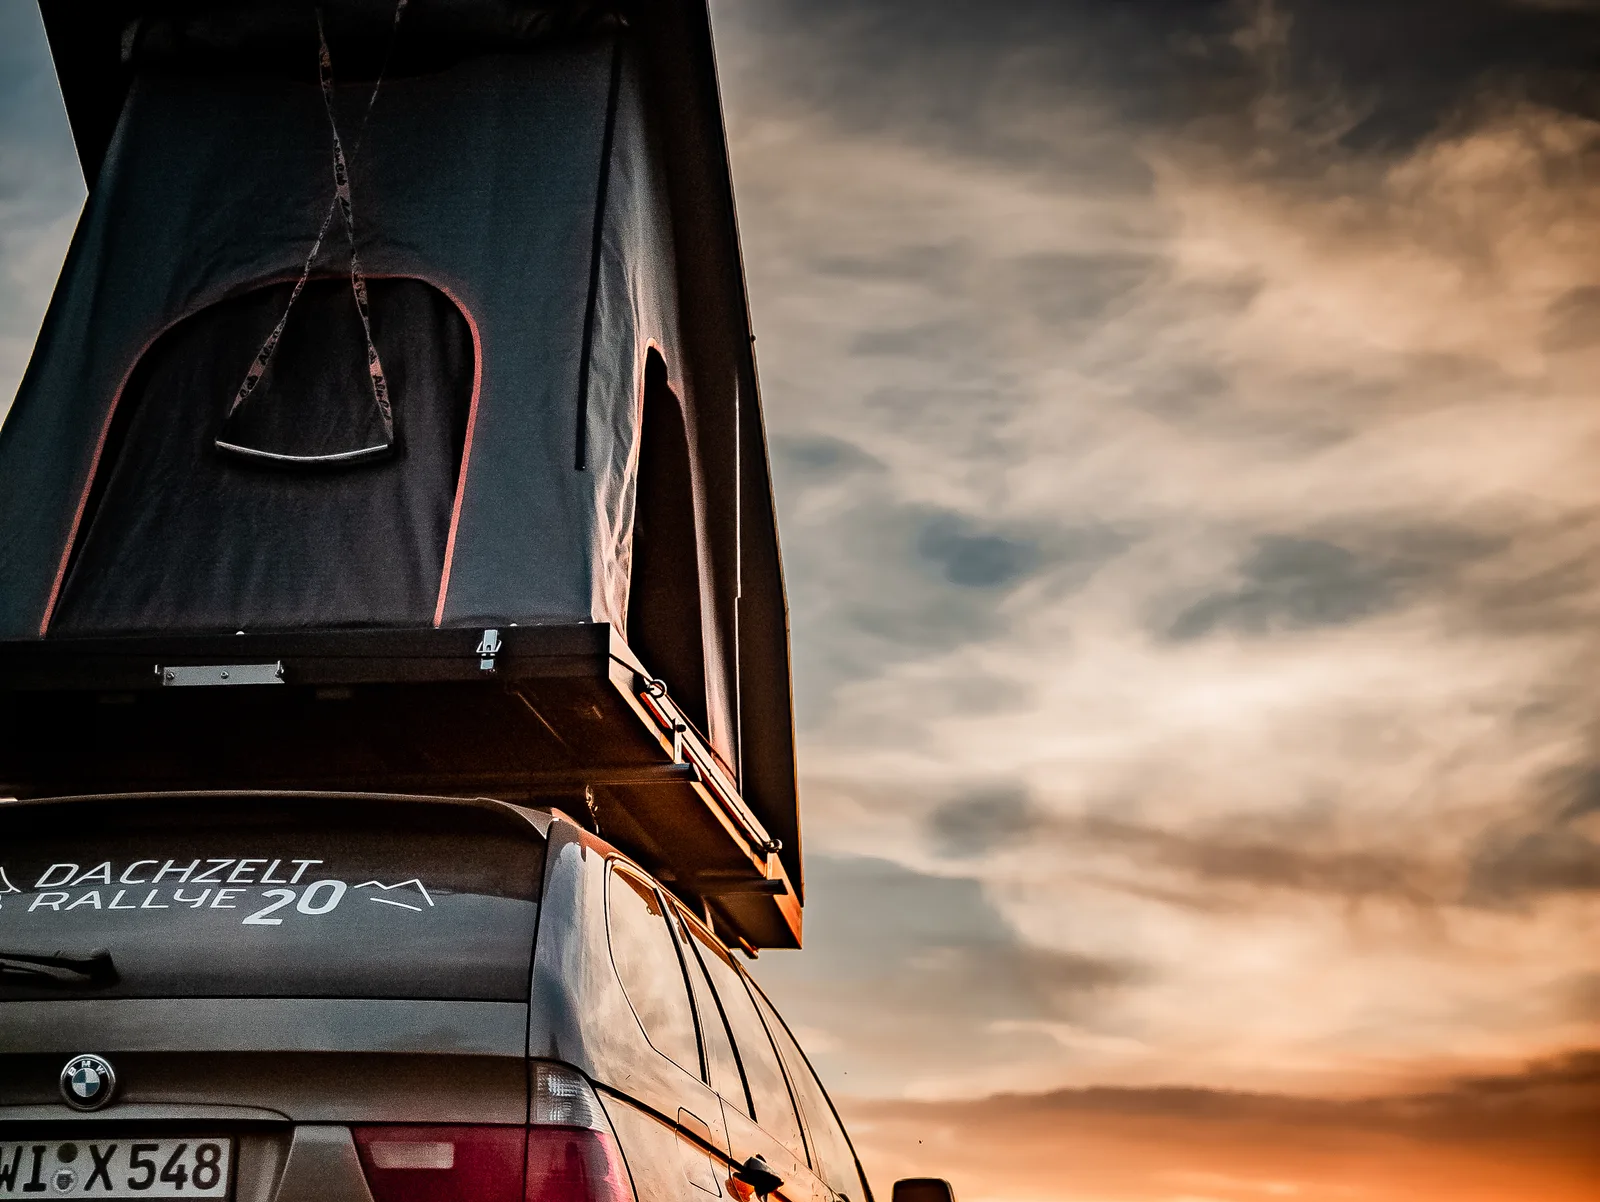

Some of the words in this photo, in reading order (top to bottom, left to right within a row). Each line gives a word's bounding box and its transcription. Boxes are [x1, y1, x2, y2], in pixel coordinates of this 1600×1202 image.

[34, 859, 324, 888] DACHZELT
[27, 888, 247, 913] RALLYE
[241, 879, 348, 927] 20
[67, 1060, 106, 1077] BMW
[84, 1144, 118, 1192] X
[127, 1143, 222, 1191] 548
